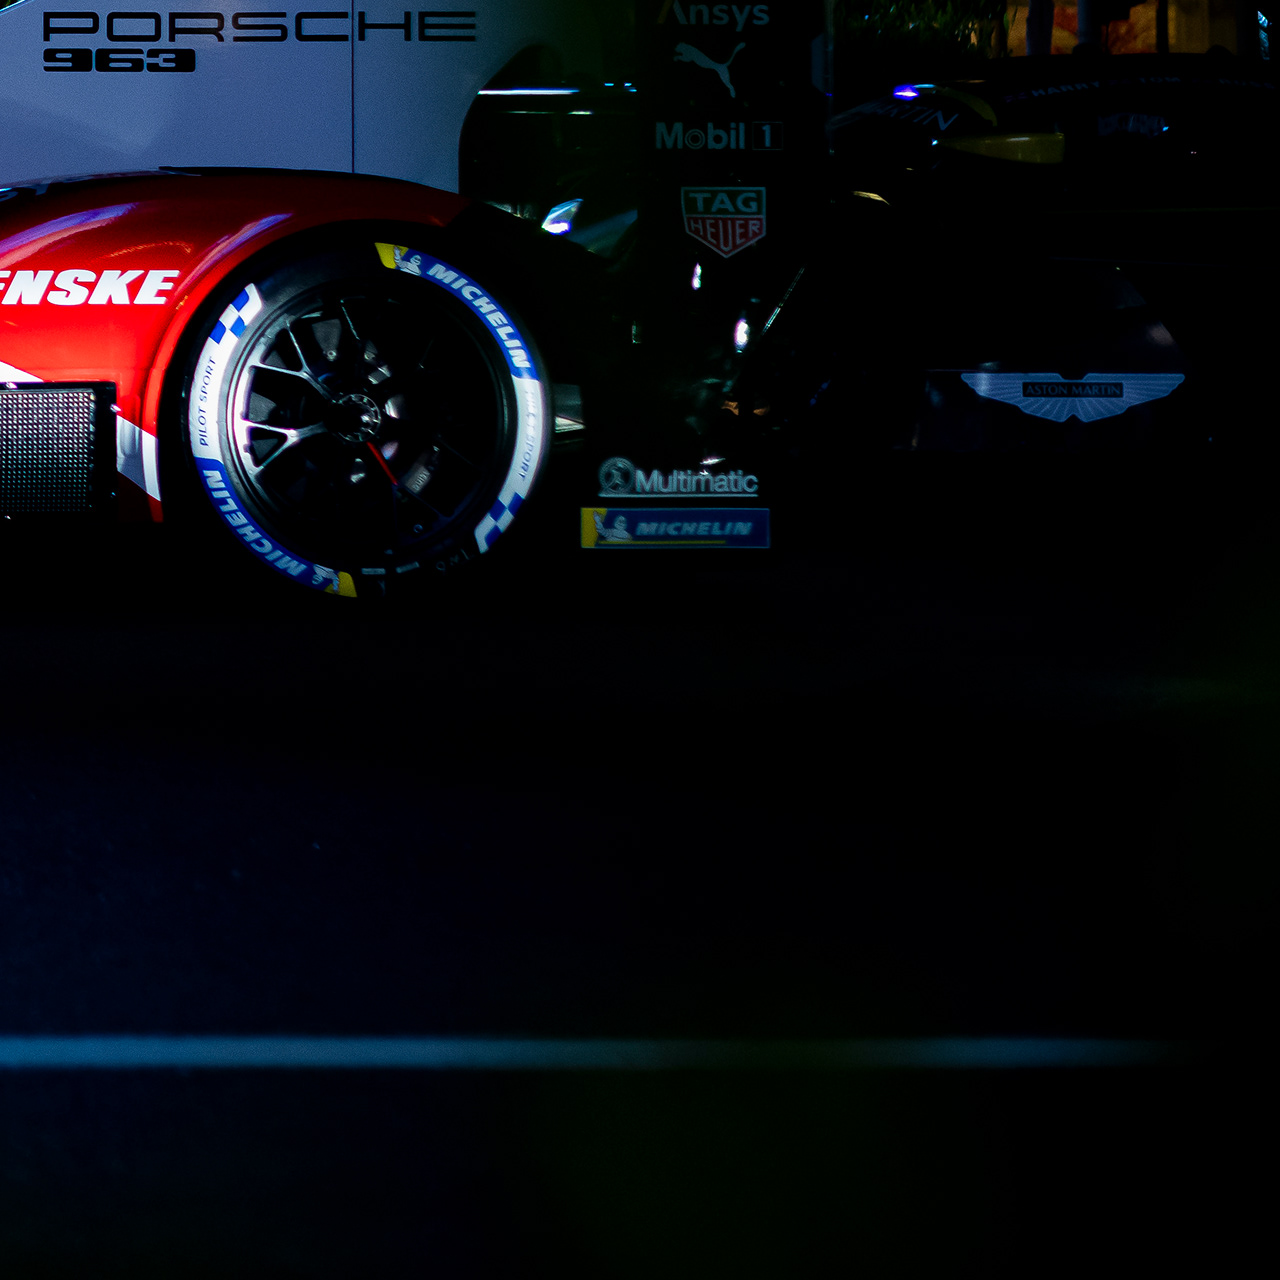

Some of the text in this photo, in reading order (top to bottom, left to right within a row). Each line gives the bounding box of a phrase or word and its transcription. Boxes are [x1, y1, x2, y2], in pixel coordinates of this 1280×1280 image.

[42, 11, 477, 42] PORSCHE
[42, 48, 197, 73] 963
[655, 121, 746, 150] Mobil
[688, 191, 759, 213] TAG
[690, 219, 761, 253] HEUER
[426, 263, 531, 369] MICHELIN
[197, 356, 217, 447] PILOT SPORT
[1025, 383, 1123, 396] ASTON MARTIN
[635, 467, 760, 493] Multimatic
[203, 469, 309, 586] MICHELIN
[635, 521, 754, 536] MICHELIN
